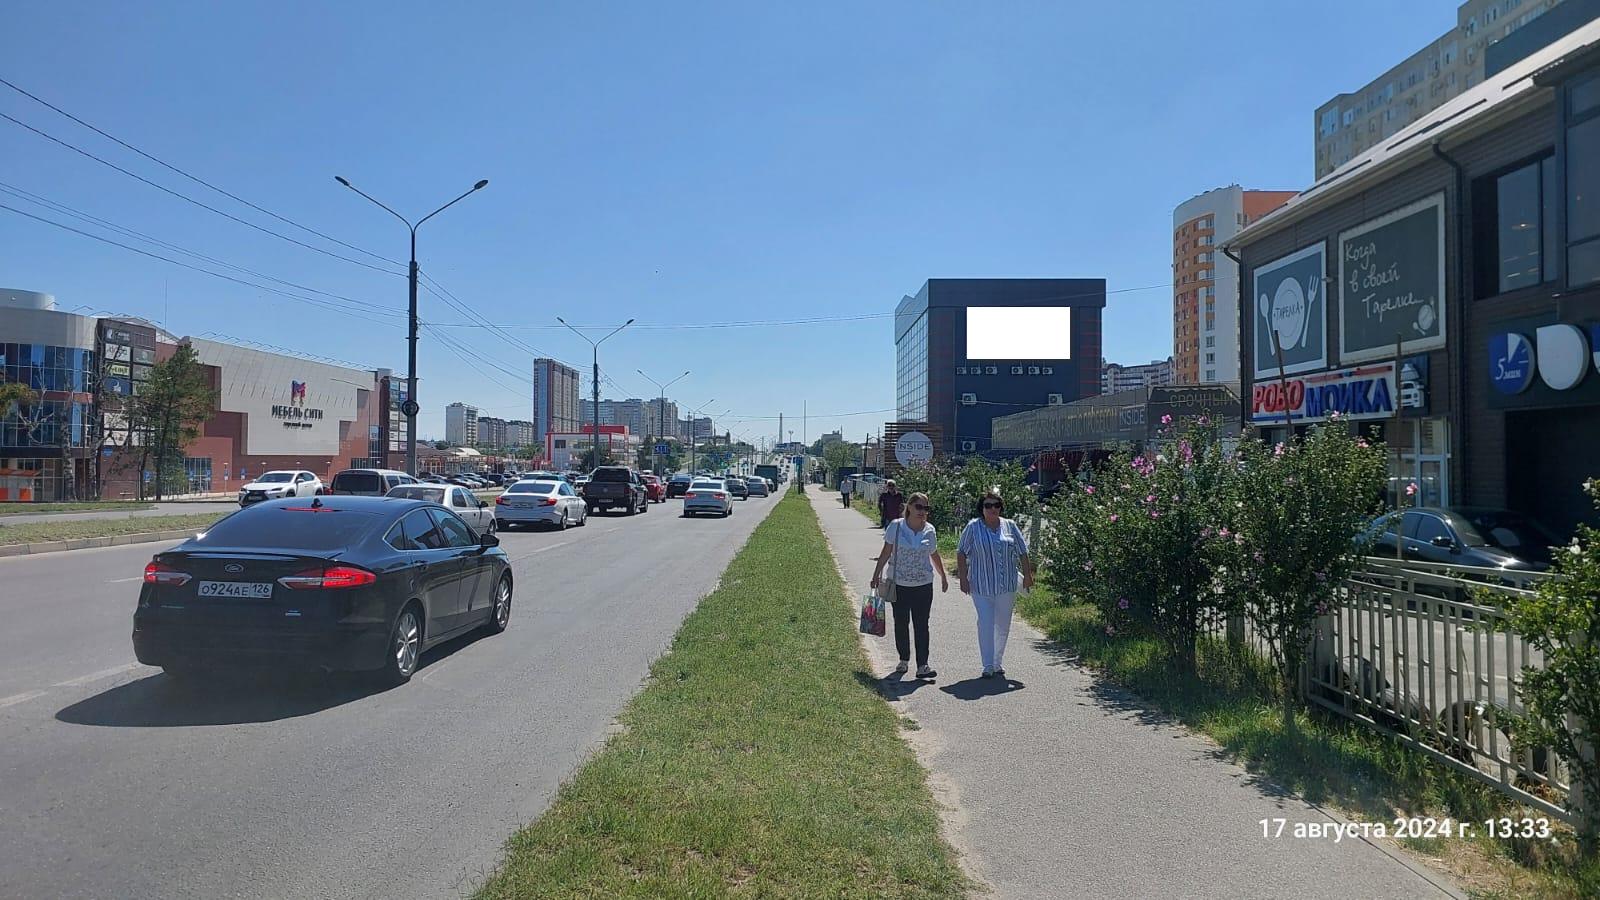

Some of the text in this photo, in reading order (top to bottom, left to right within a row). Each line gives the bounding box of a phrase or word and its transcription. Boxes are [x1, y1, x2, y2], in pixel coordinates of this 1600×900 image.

[1346, 242, 1376, 270] Когда
[1349, 262, 1401, 293] в своей
[1274, 301, 1301, 319] ТАРЕЛКА
[1362, 292, 1424, 322] Тарелке
[1495, 357, 1506, 380] 5
[1253, 380, 1305, 413] РОБО
[271, 404, 324, 419] МЕБЕЛЬ СИТИ
[1120, 407, 1145, 425] INSIDE
[897, 442, 931, 450] INSIDE
[252, 583, 270, 594] 126
